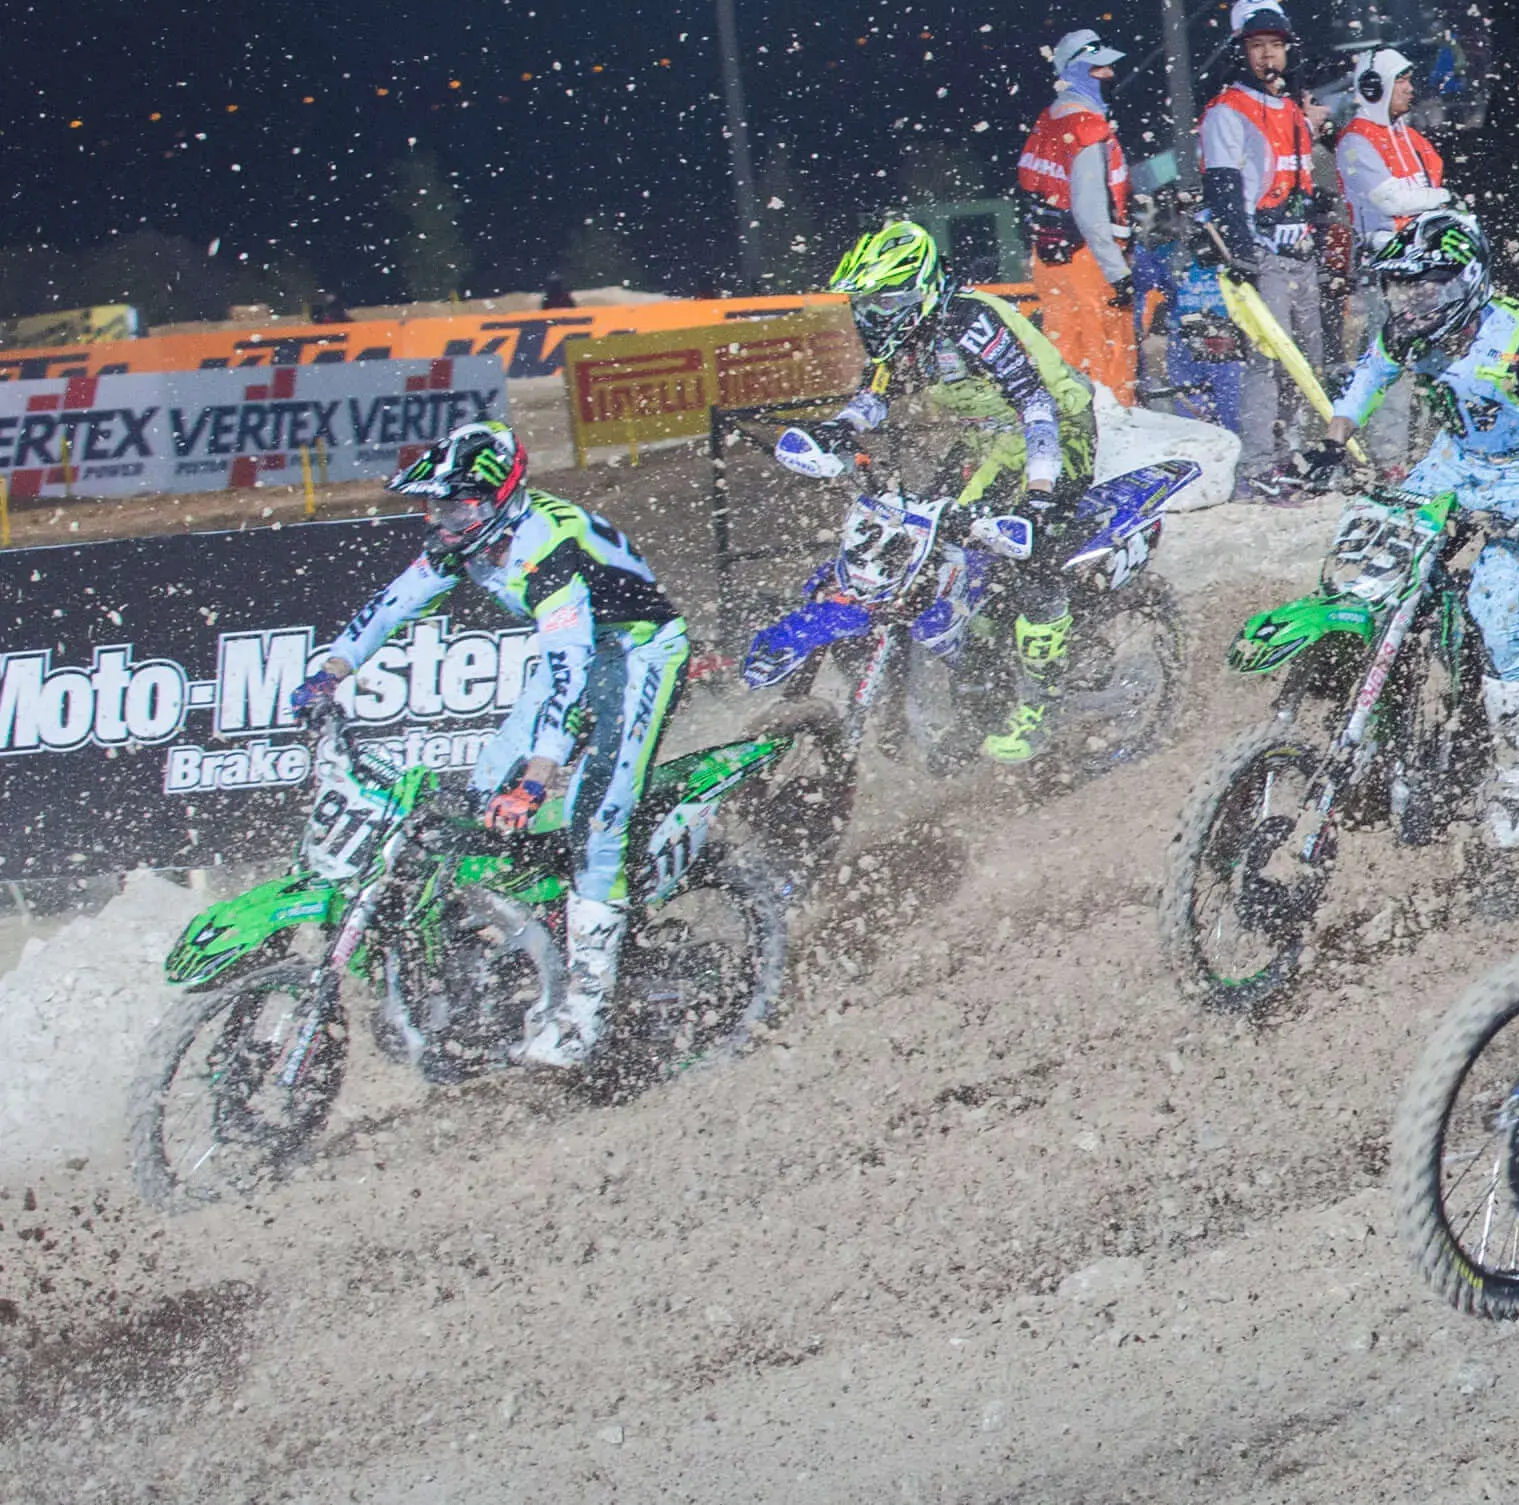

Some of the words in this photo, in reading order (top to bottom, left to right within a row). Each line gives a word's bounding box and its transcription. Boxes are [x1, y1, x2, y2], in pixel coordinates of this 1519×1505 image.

[960, 312, 995, 355] FLY
[167, 399, 343, 457] VERTEX
[165, 741, 312, 794] Brake
